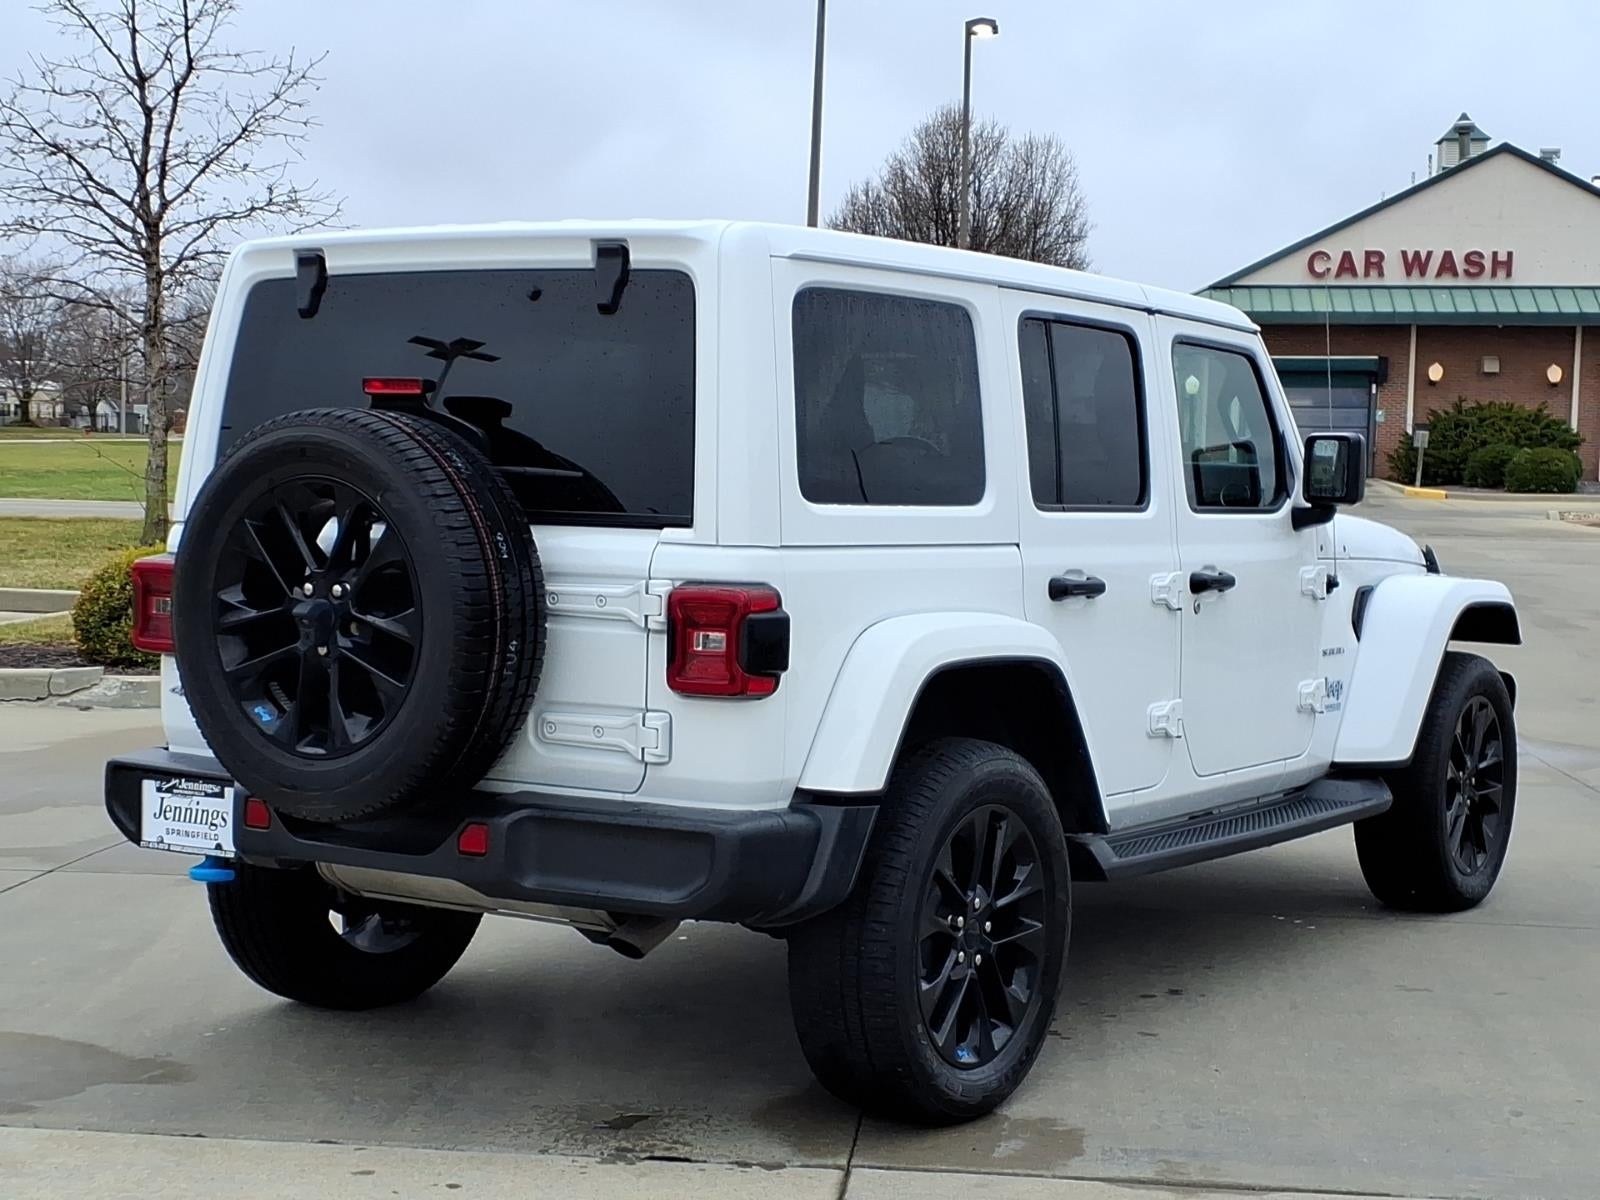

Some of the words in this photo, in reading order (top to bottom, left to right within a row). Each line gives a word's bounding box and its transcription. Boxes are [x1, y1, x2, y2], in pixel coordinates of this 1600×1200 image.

[1307, 250, 1386, 279] CAR
[1400, 249, 1514, 279] WASH
[153, 797, 229, 831] Jennings
[165, 827, 219, 841] SPRINGFIELD
